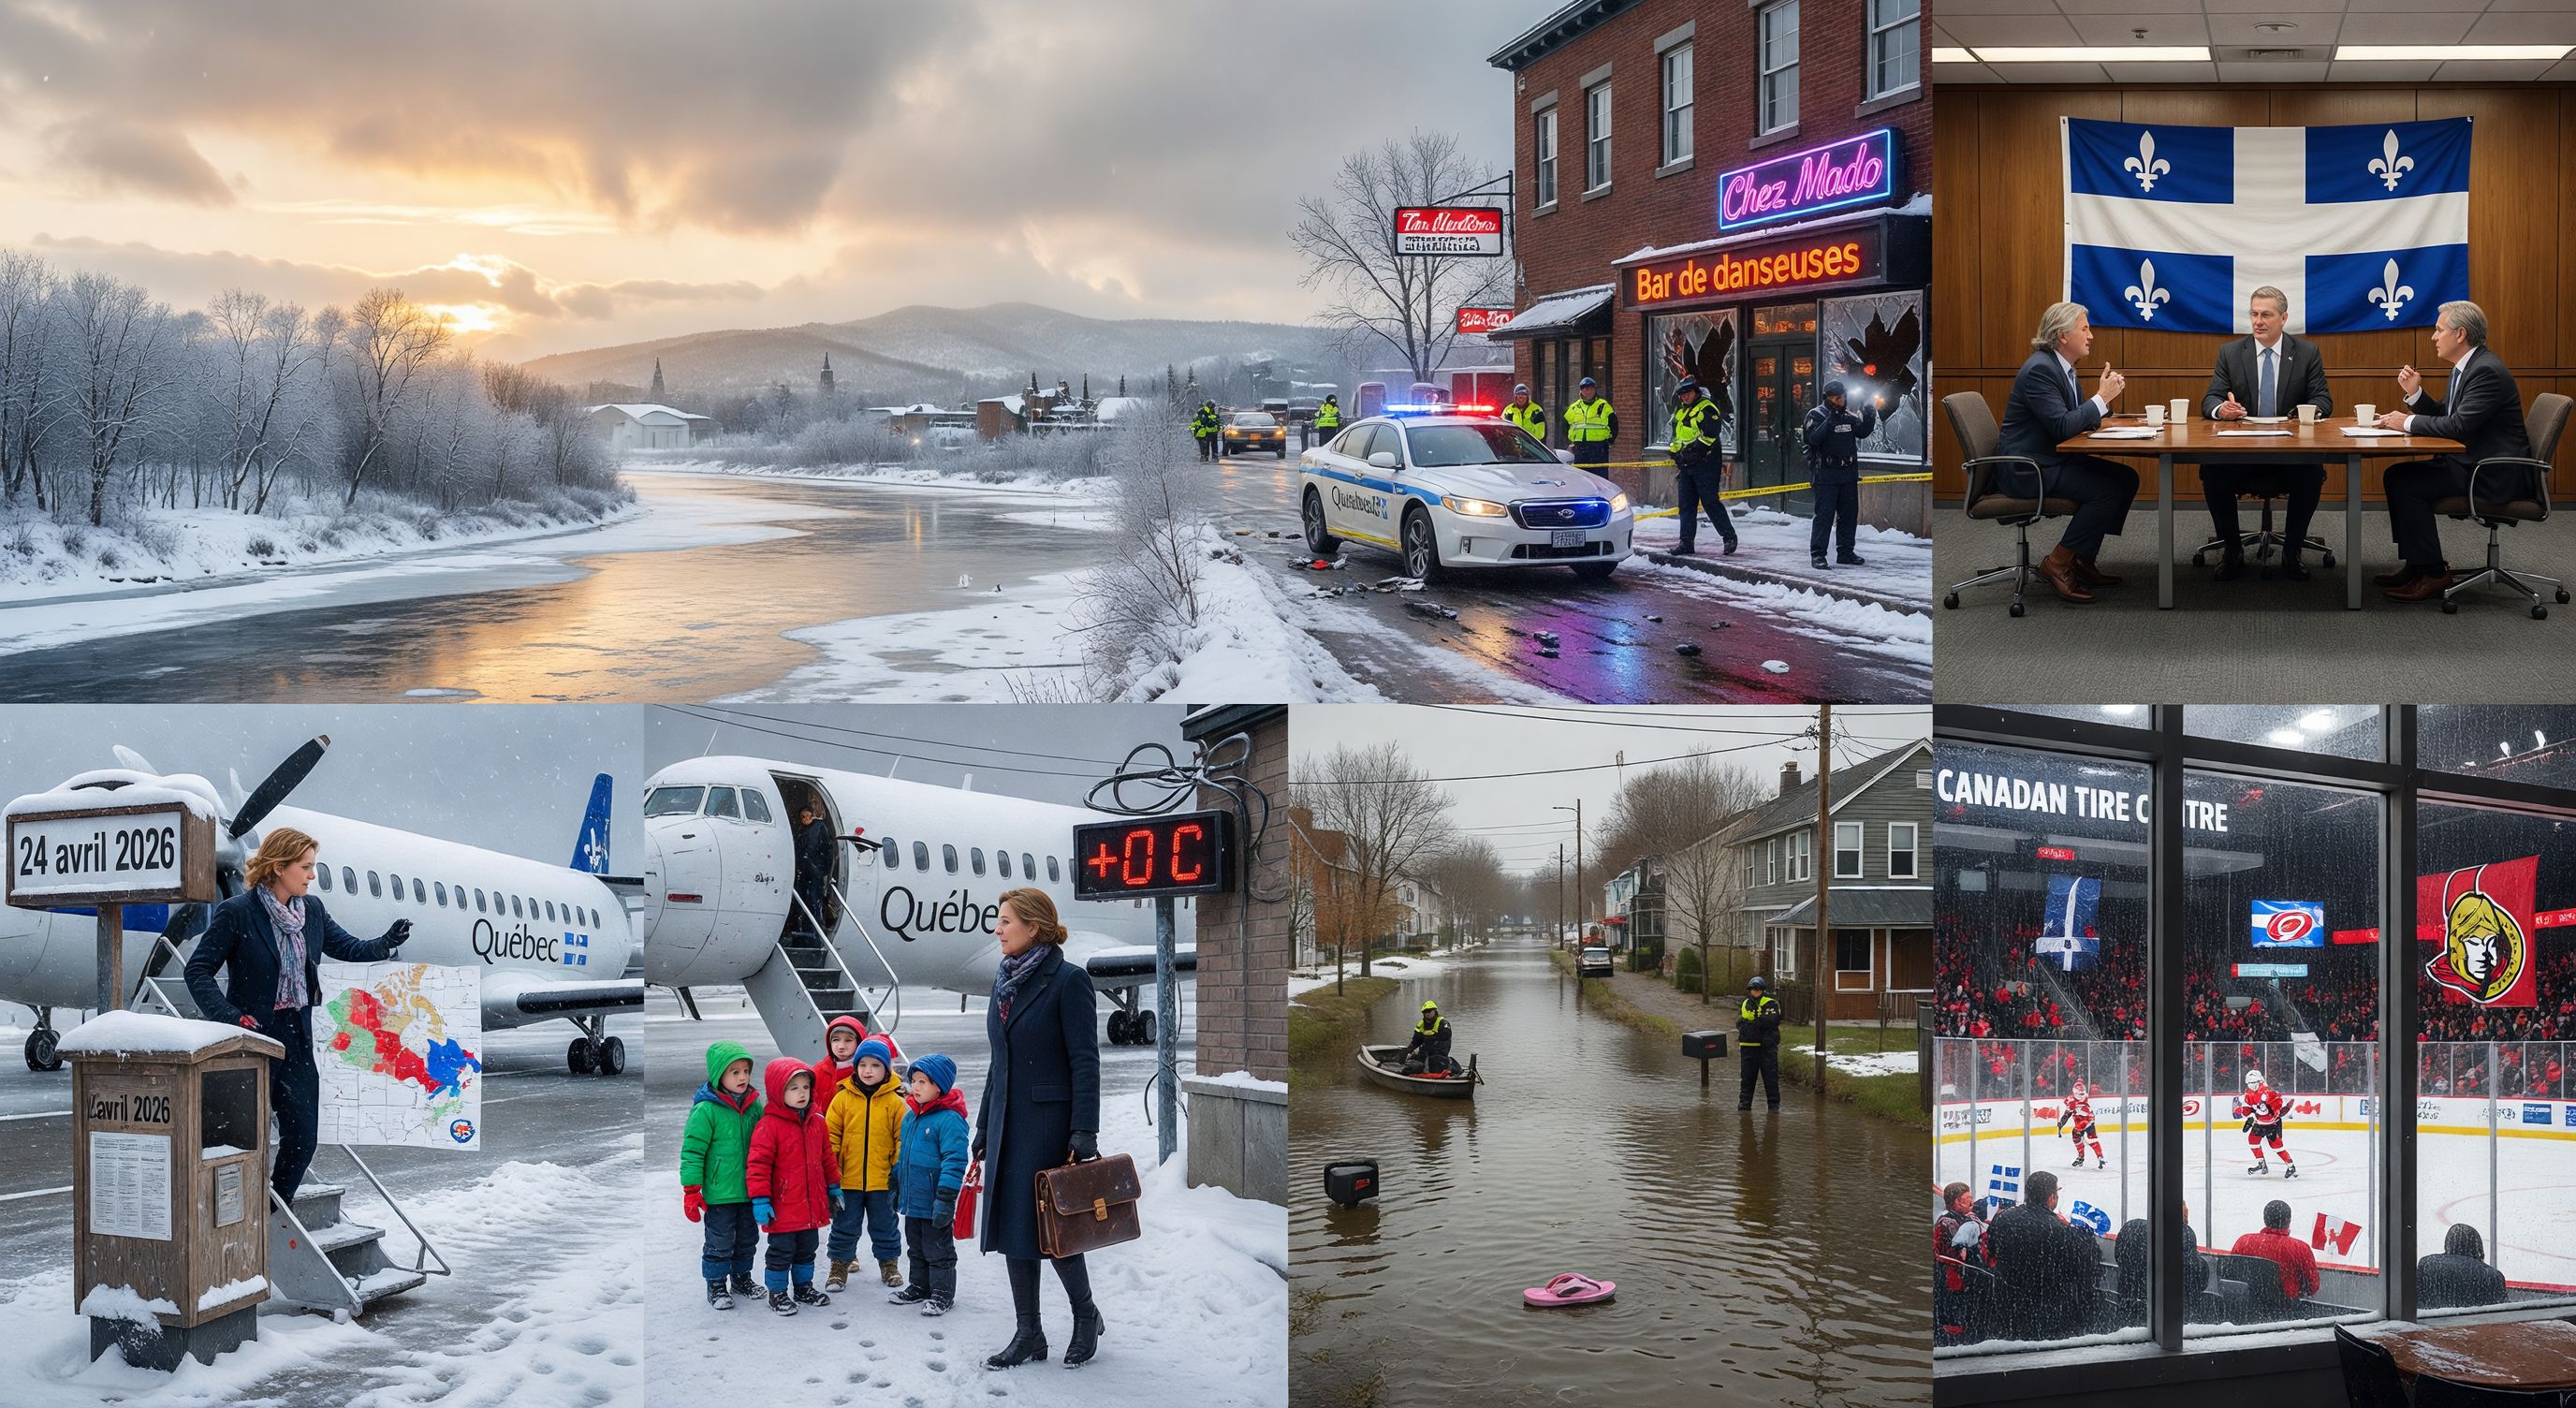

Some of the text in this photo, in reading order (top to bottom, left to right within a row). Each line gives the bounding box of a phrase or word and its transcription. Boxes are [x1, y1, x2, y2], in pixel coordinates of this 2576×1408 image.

[1723, 142, 1883, 221] Chez Mado
[1638, 242, 1860, 301] Bar de danseuses
[1937, 769, 2228, 832] CANADAN TIRE CTRE
[20, 827, 175, 876] 24 avril 2026
[472, 918, 559, 965] Québec
[881, 886, 999, 942] Québe
[133, 1095, 170, 1123] 2026
